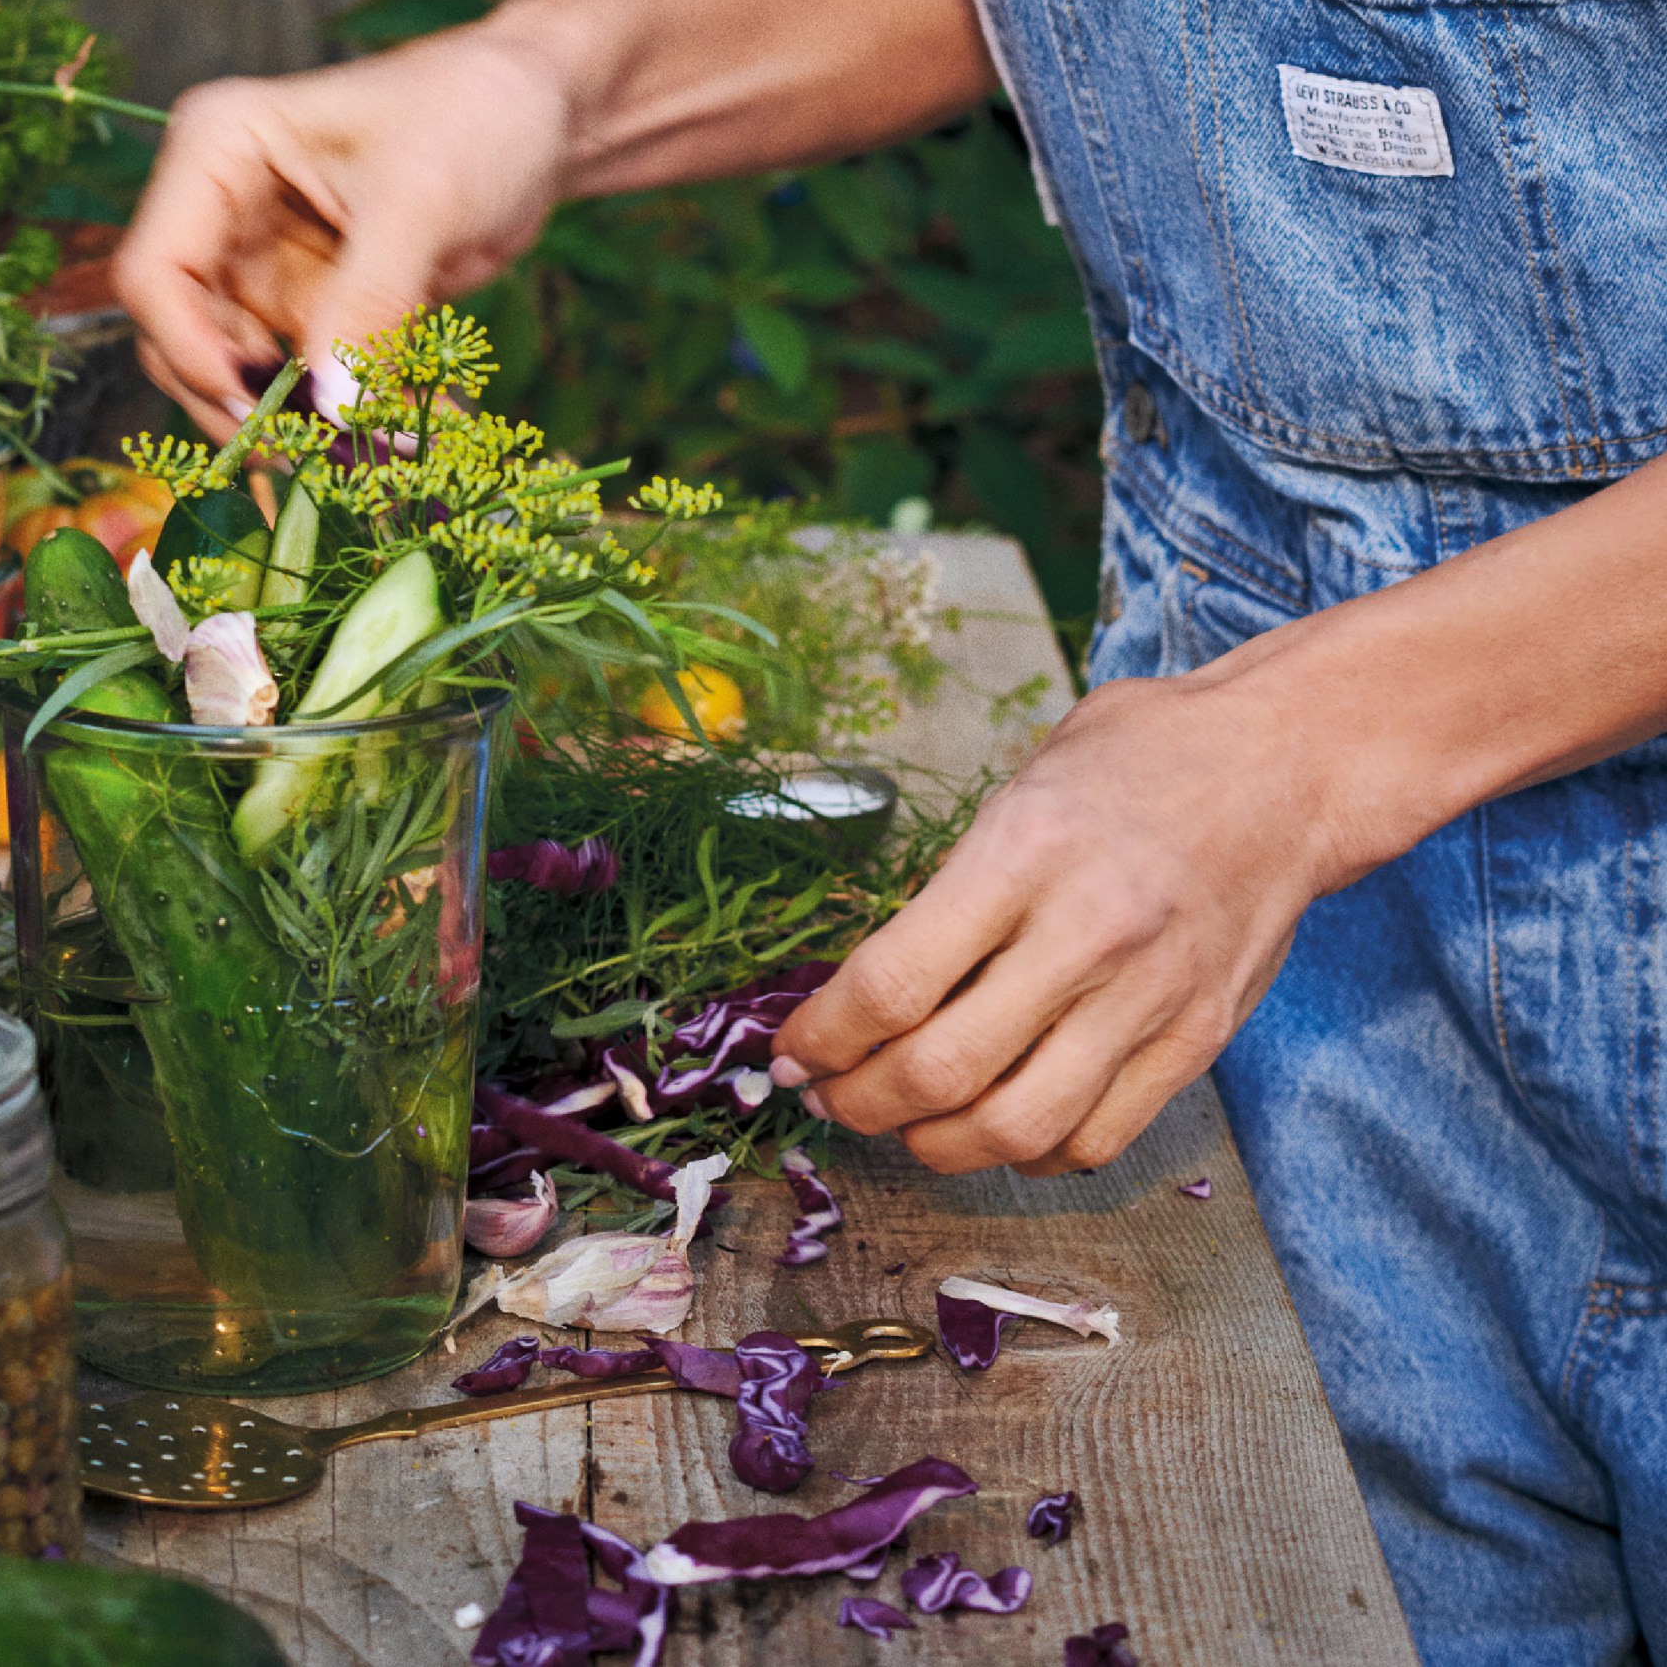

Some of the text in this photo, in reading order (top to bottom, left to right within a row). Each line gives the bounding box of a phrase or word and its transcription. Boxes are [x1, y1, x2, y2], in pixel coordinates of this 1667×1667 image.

[1296, 85, 1319, 101] LEVI
[1324, 89, 1379, 110] STRAUSS
[1383, 99, 1391, 112] &
[1328, 123, 1372, 139] Horse
[1378, 128, 1422, 144] Brand
[1383, 141, 1427, 156] Denim
